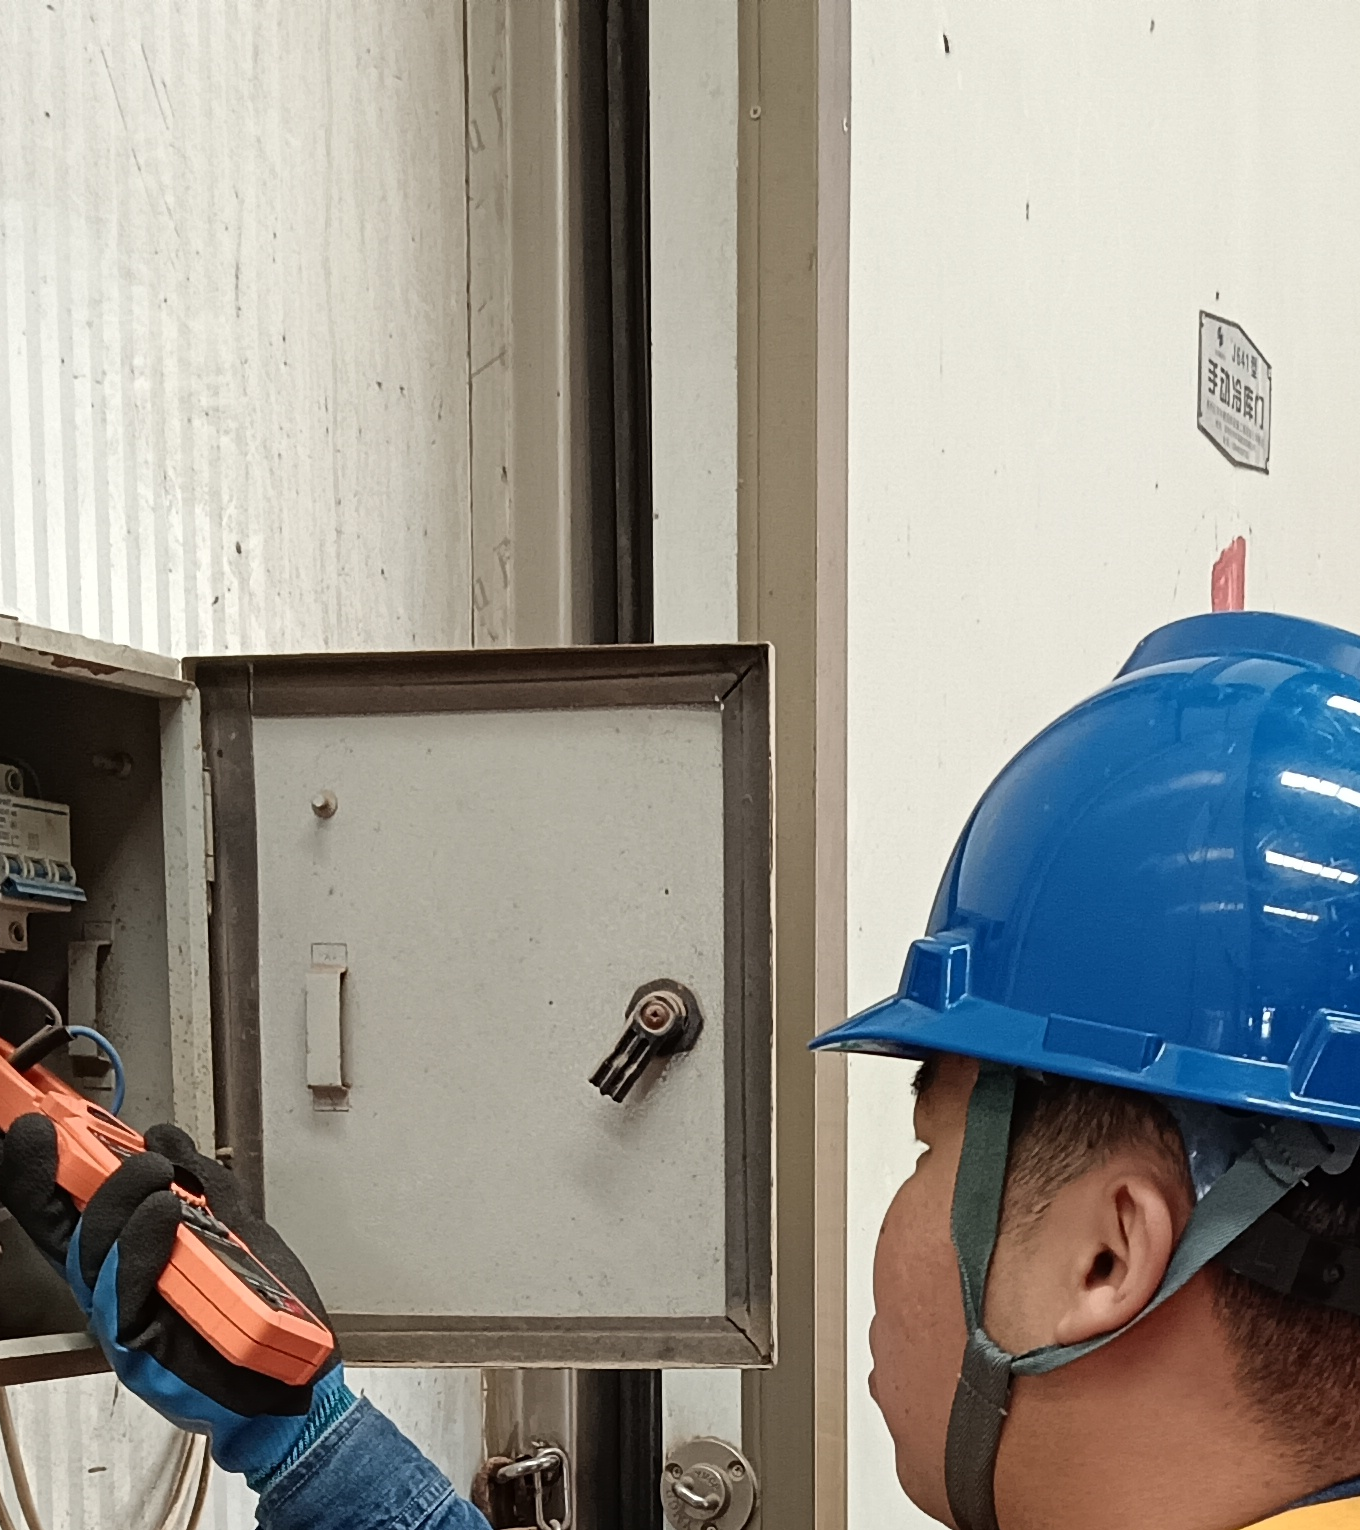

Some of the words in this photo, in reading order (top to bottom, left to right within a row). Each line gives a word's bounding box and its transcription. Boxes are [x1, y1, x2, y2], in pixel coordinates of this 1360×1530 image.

[1207, 358, 1265, 430] 手动冷库门
